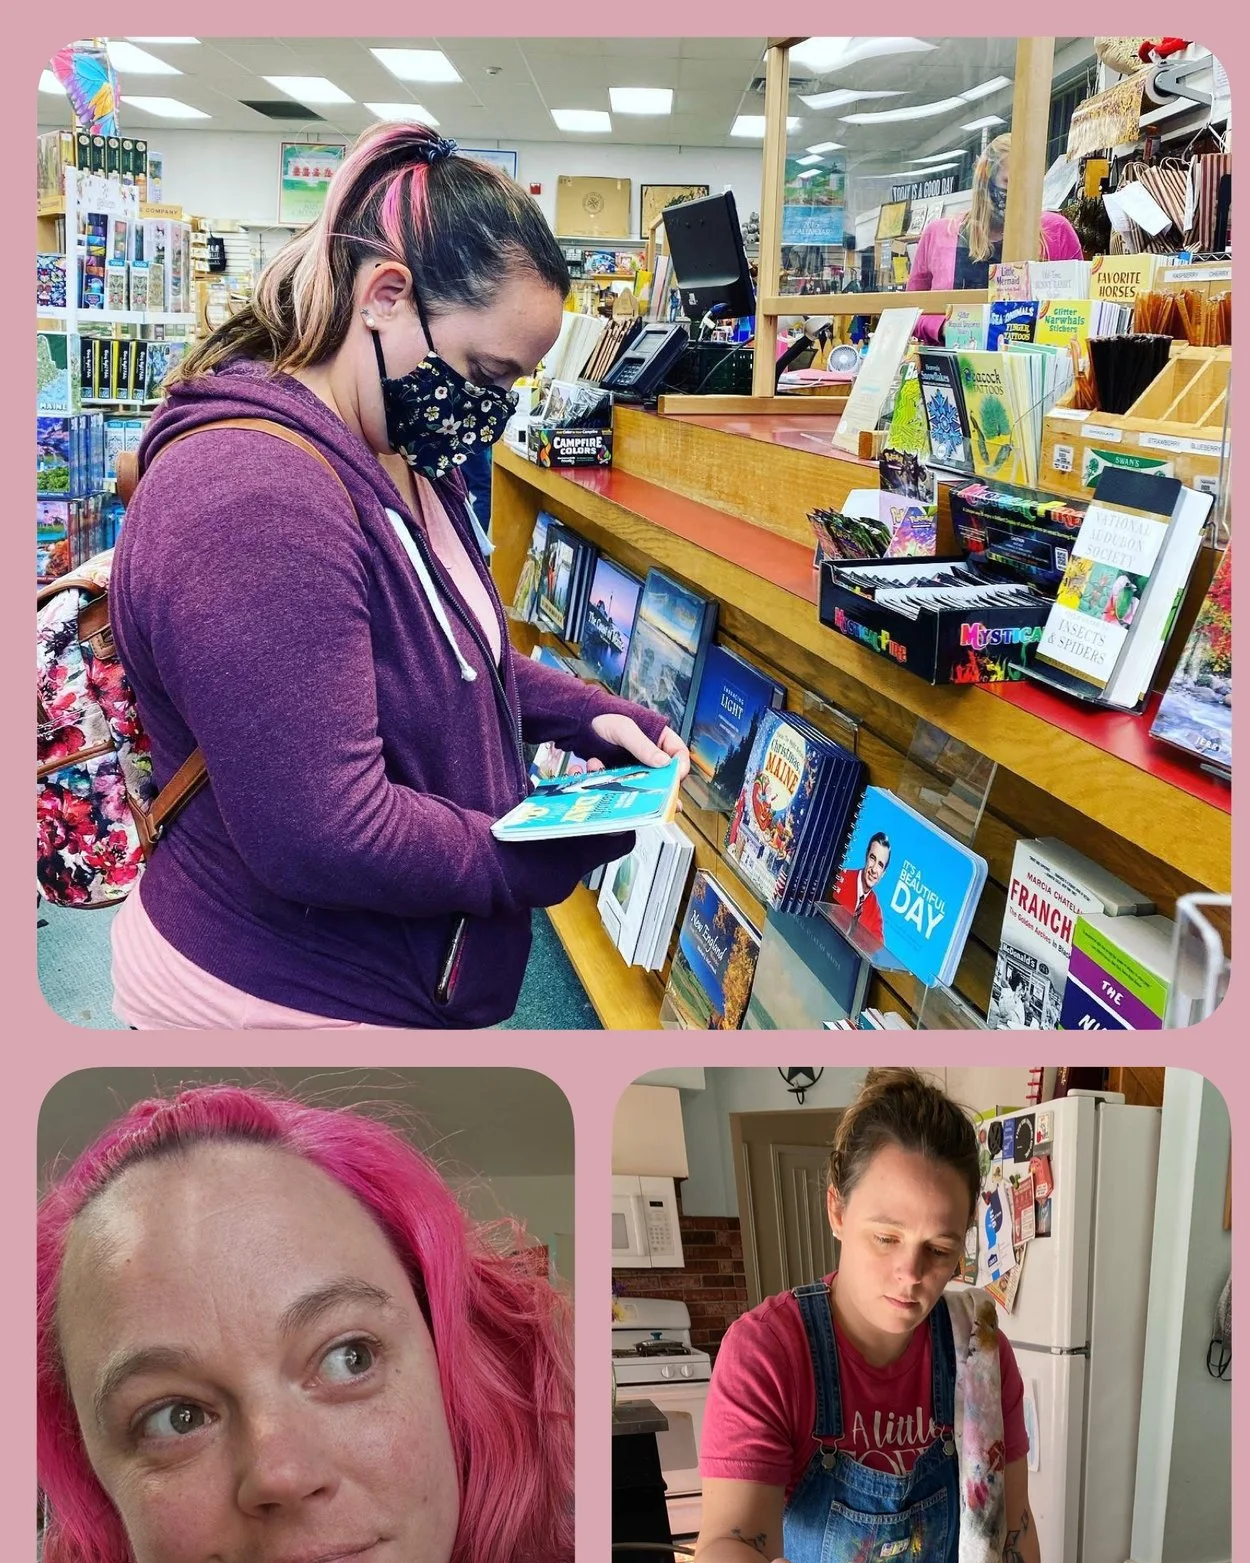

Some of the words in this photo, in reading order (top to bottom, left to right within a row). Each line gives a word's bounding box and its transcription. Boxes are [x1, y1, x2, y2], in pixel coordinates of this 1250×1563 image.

[145, 207, 179, 215] COMPANY
[1097, 271, 1141, 284] FAVORITE
[1099, 285, 1136, 298] HORSES
[1044, 316, 1085, 326] Narwhals
[1053, 308, 1078, 316] Glitter
[1003, 332, 1031, 341] TATTOOS
[1006, 323, 1030, 333] FINGER
[1049, 325, 1078, 333] Stickers
[973, 384, 1004, 396] TATTOOS
[553, 436, 603, 449] CAMPFIRE
[560, 447, 597, 455] COLORS
[1147, 437, 1180, 447] STRAWBERRY
[1191, 442, 1222, 452] BLUEBERRY
[1115, 456, 1140, 467] SWAN'S
[1095, 510, 1151, 537] NATIONAL
[1090, 529, 1146, 552] AUDUBON
[1085, 544, 1136, 569] SOCIETY
[1058, 619, 1107, 647] INSECTS
[1047, 634, 1055, 644] &
[1059, 637, 1107, 665] SPIDERS
[720, 693, 744, 720] LIGHT
[723, 685, 744, 706] EMBRACING
[770, 739, 801, 772] Christmas
[765, 751, 799, 796] MAINE
[902, 859, 916, 875] IT'S
[915, 870, 921, 880] A
[900, 868, 945, 914] BEAUTIFUL
[1027, 872, 1052, 895] MARCIA
[1054, 891, 1083, 914] CHATELA
[890, 879, 945, 940] DAY
[1010, 878, 1073, 944] FRANCH
[690, 910, 704, 933] New
[702, 922, 728, 961] England
[1009, 906, 1018, 918] The
[1017, 913, 1034, 932] Golden
[1034, 927, 1051, 944] Arches
[1002, 943, 1036, 968] McDonald's
[1101, 980, 1124, 1006] THE
[852, 1410, 870, 1449] A
